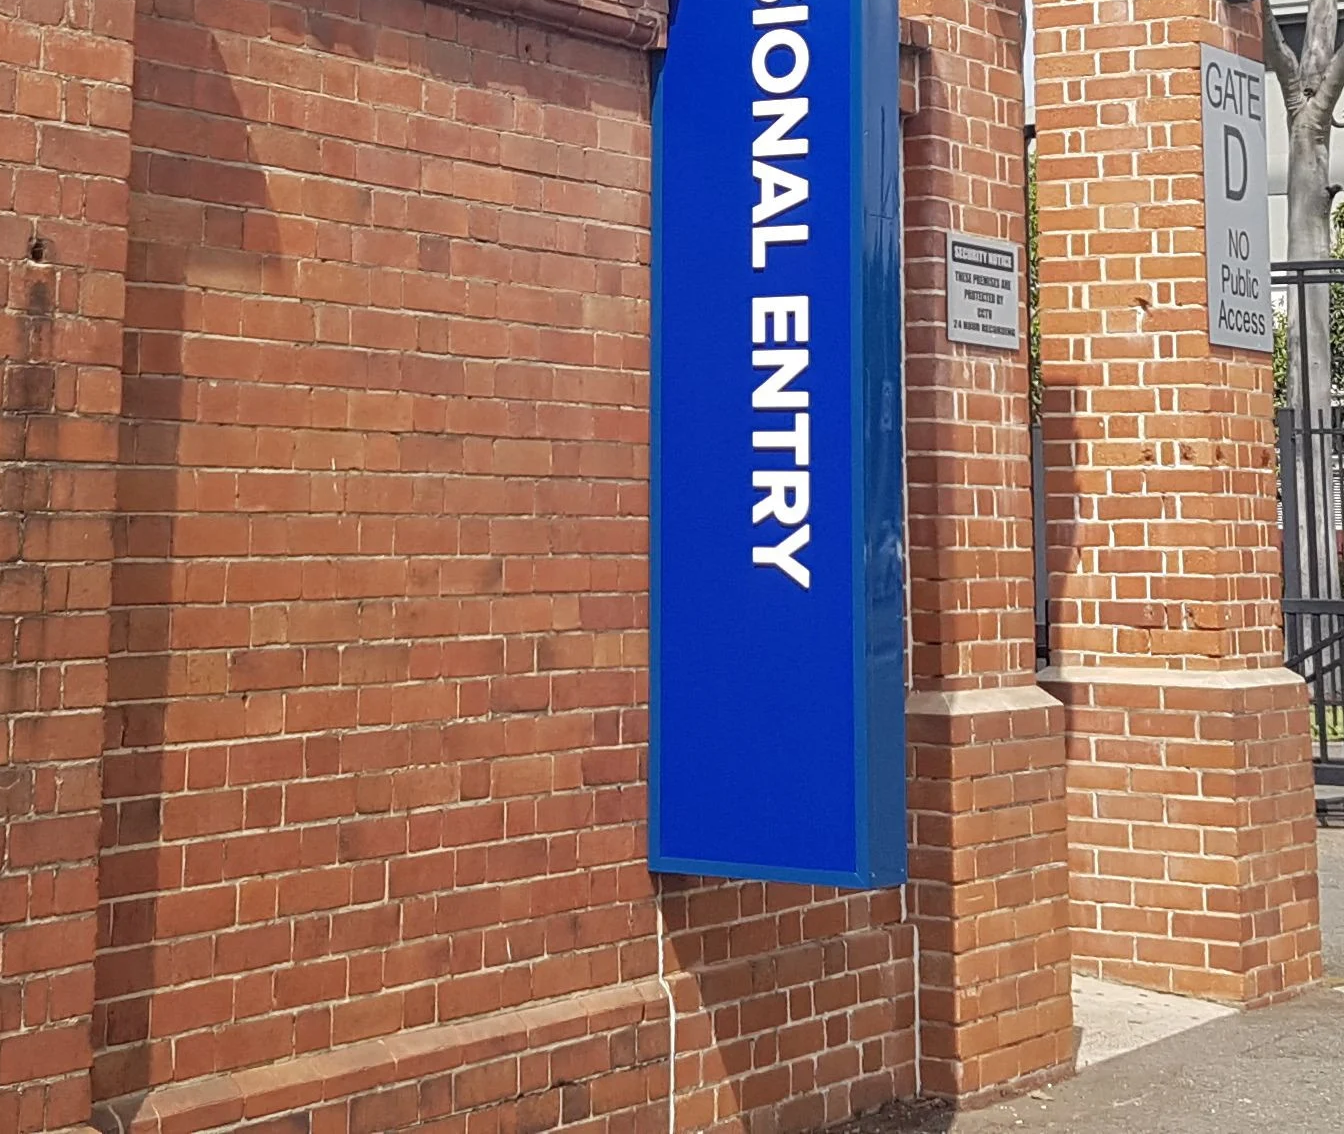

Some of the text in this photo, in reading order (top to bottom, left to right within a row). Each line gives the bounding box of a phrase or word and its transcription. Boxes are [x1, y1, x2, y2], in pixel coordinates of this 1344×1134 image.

[1206, 61, 1261, 121] GATE
[1223, 123, 1248, 202] D
[954, 245, 1012, 268] SECURITY NOTICE
[1228, 228, 1250, 261] NO
[955, 270, 971, 283] THESE
[972, 273, 1000, 288] PREMISES
[964, 288, 996, 304] PROTECTED
[1221, 264, 1259, 299] Public
[1218, 299, 1266, 336] Access
[751, 295, 810, 589] ENTRY
